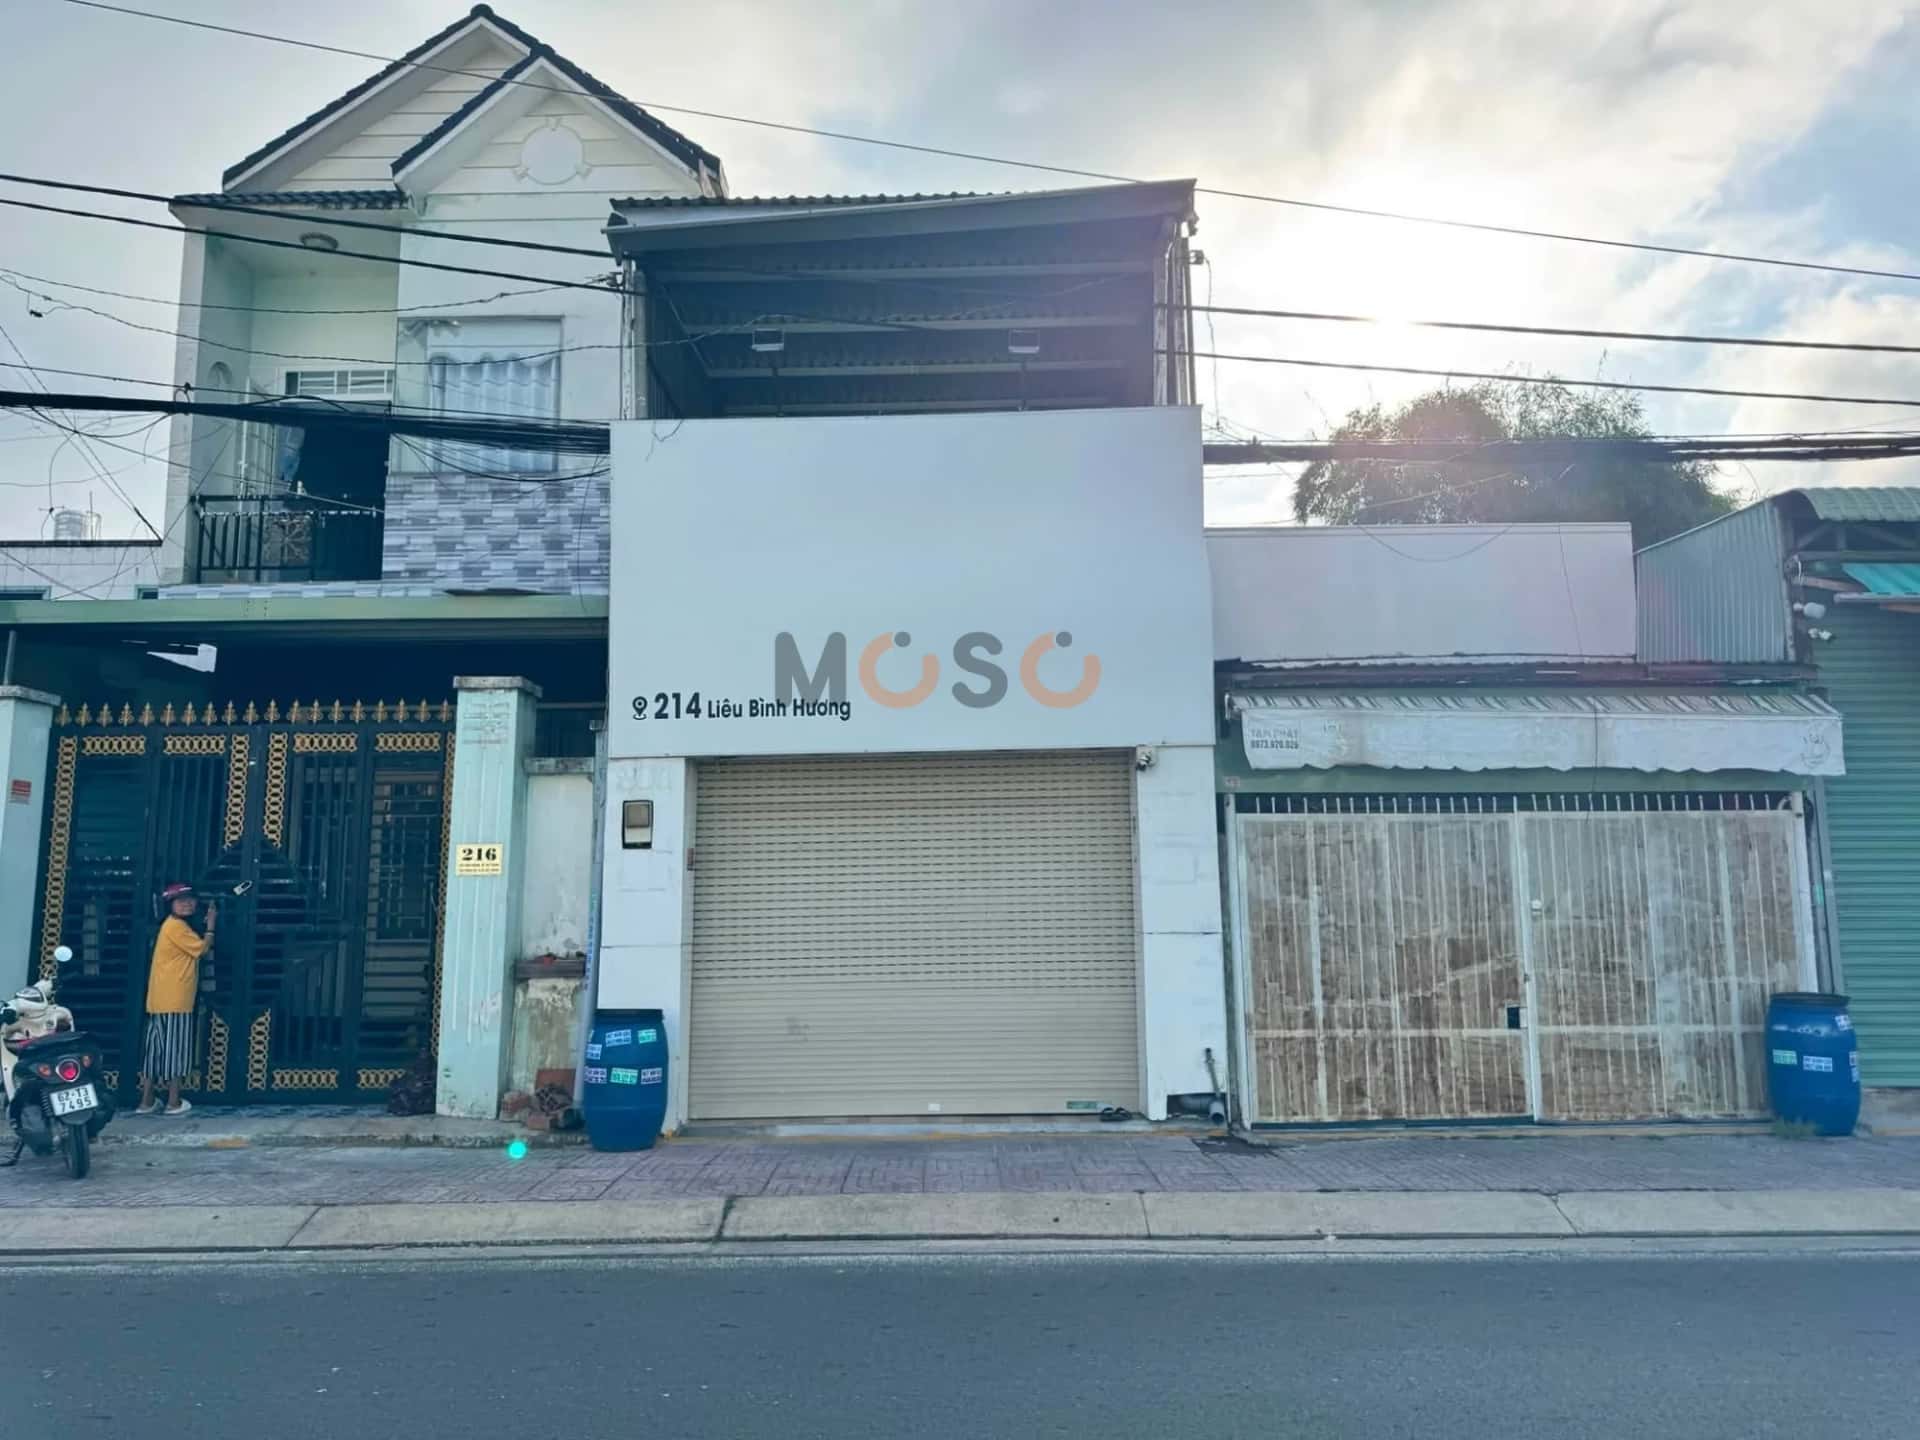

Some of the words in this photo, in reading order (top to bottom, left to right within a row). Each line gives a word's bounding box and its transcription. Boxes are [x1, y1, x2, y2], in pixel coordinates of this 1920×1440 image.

[654, 691, 701, 720] 214
[707, 698, 743, 718] Liêu
[749, 697, 787, 718] Bình
[793, 698, 851, 721] Hương
[462, 847, 497, 861] 216
